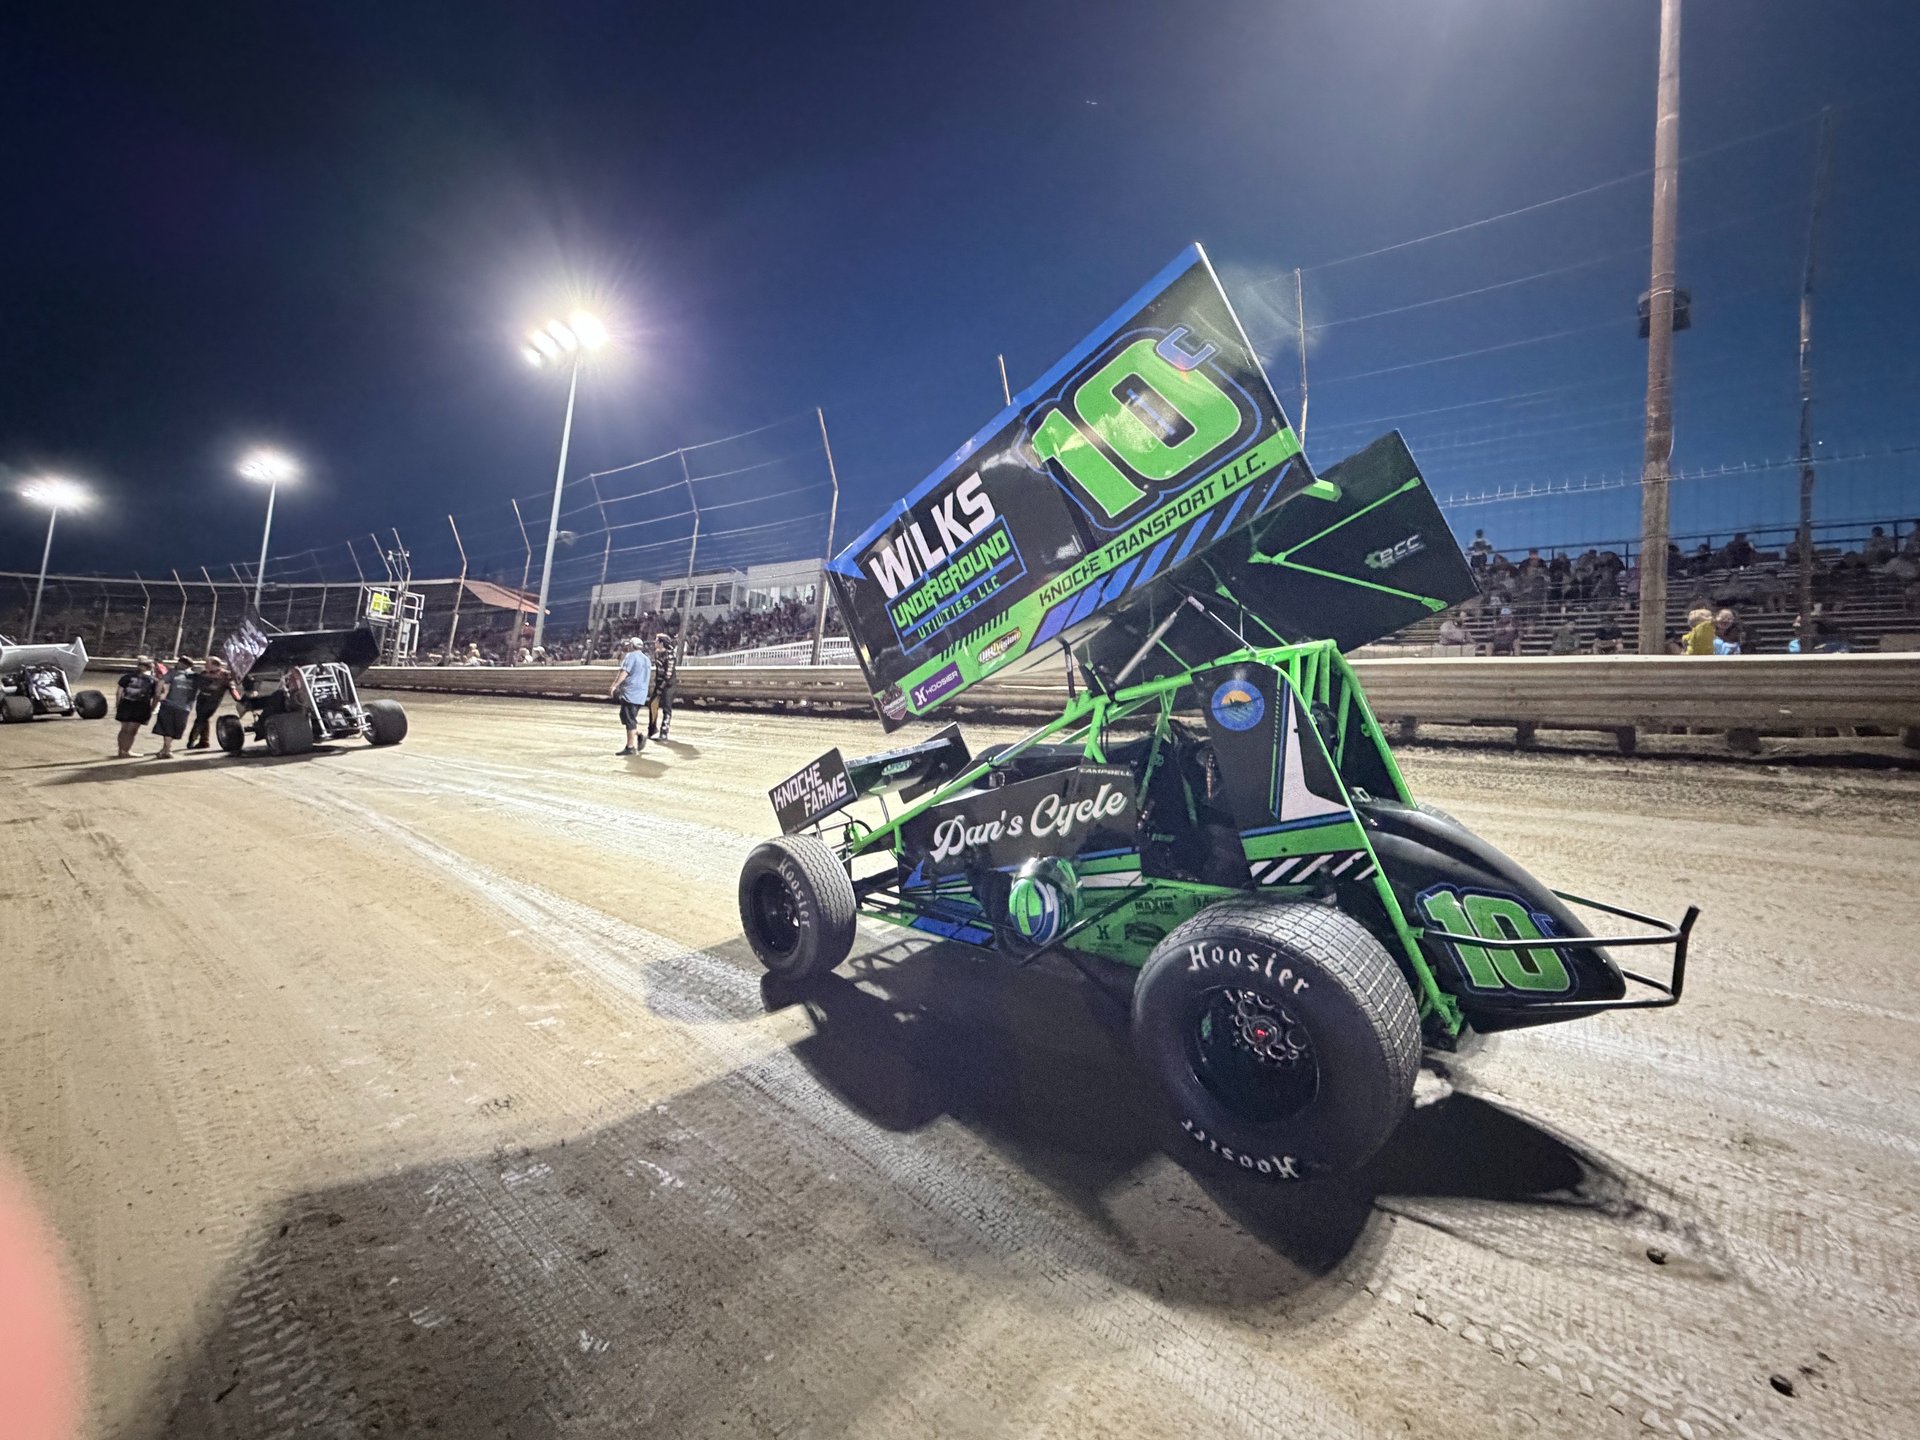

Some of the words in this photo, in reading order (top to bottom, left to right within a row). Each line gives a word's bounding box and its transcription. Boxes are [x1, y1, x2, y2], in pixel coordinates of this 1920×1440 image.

[869, 472, 995, 598] WILKS
[1039, 555, 1101, 606] KNOCHE
[1105, 482, 1215, 562] TRANSPORT
[1222, 453, 1266, 491] LLC.
[892, 529, 1011, 628] UNDERGROUND
[977, 576, 1000, 598] LLC
[926, 670, 959, 695] HOOSIER
[773, 762, 822, 812] KNOCHE
[803, 772, 847, 818] FARMS
[1079, 768, 1133, 777] CAMPBELL
[930, 810, 1024, 863] Dan's
[1030, 783, 1127, 838] Cycle
[777, 857, 811, 929] Hoosier
[1188, 941, 1309, 995] Hoosier
[1181, 1118, 1299, 1179] Hoosier
